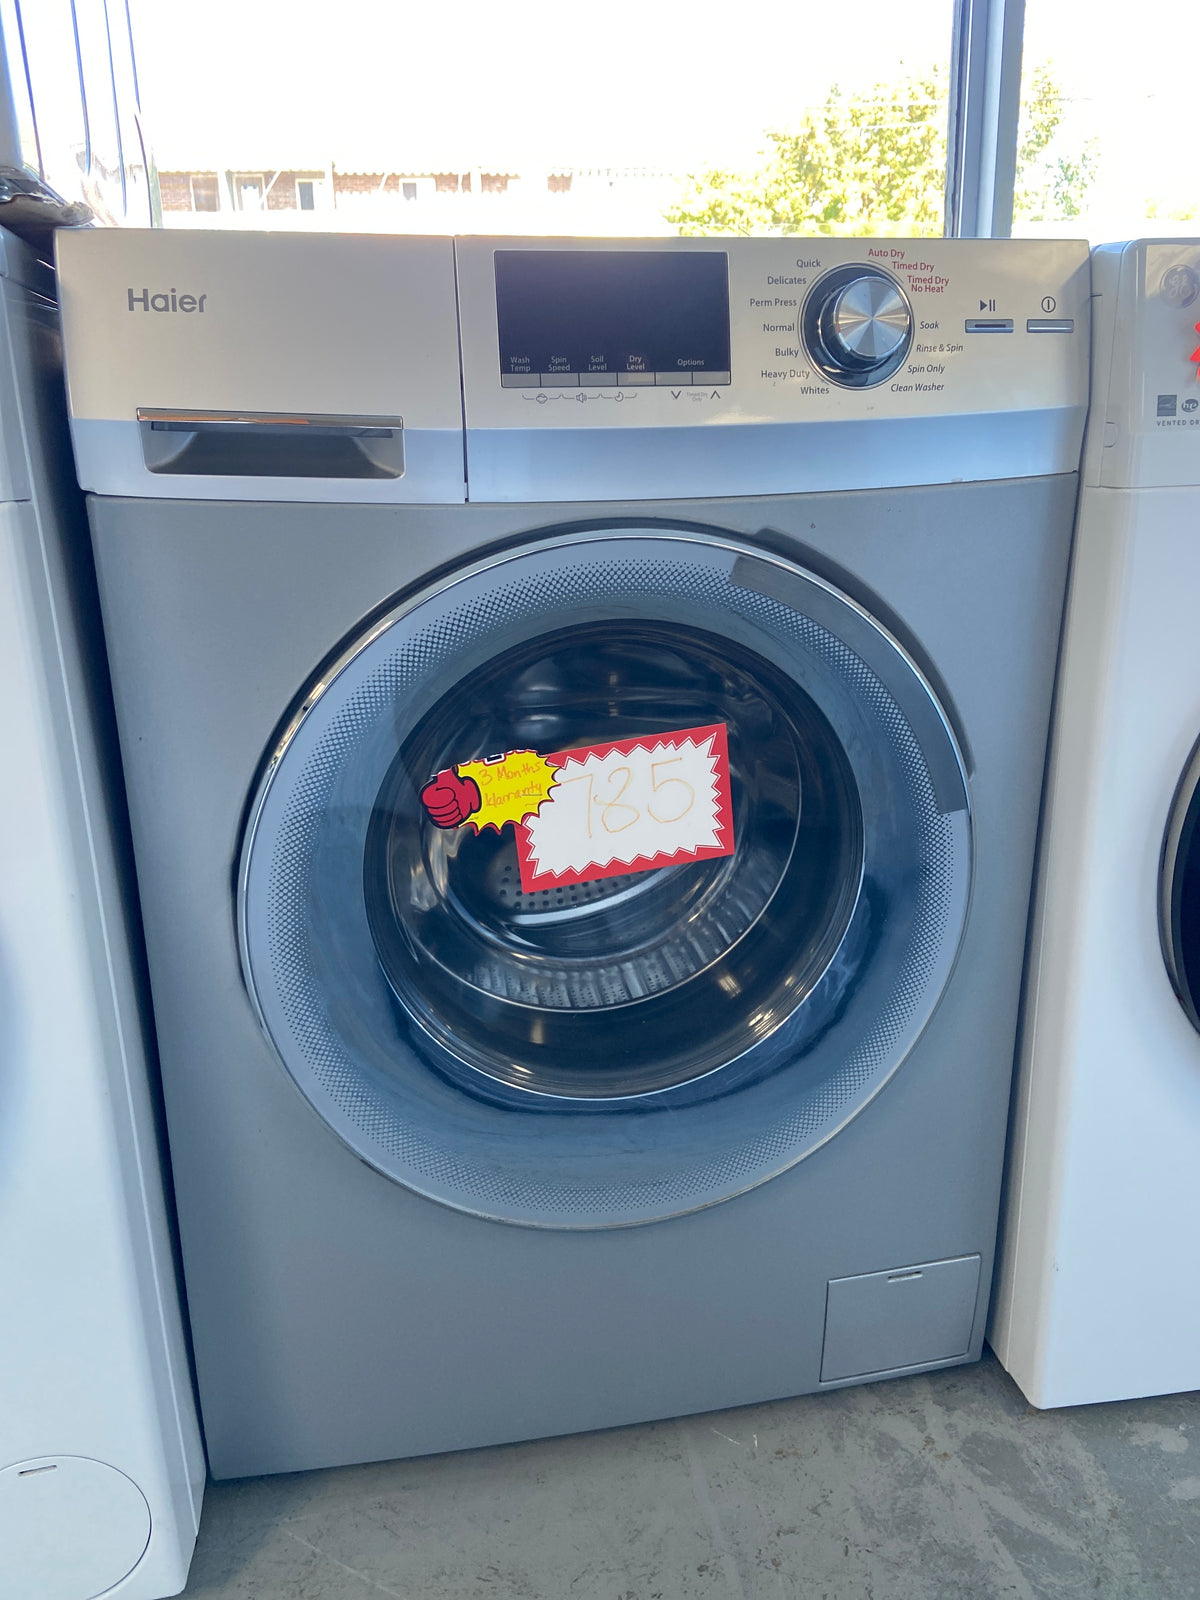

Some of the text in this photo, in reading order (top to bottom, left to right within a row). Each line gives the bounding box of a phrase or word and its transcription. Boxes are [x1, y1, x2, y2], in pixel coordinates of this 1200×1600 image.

[868, 248, 905, 260] Auto Dry
[796, 259, 822, 268] Quick
[892, 261, 935, 272] Timed Dry
[767, 275, 807, 285] Delicates
[907, 275, 950, 286] Timed Dry
[911, 284, 944, 293] No Heat
[127, 288, 207, 312] Haier
[750, 298, 797, 307] Perm Press
[763, 323, 795, 332] Normal
[920, 320, 939, 329] Soak
[916, 343, 964, 353] Rinse & Spin
[775, 348, 799, 358] Bulky
[510, 356, 530, 364] Wash
[551, 356, 567, 364] Spin
[629, 355, 642, 364] Dry
[677, 358, 705, 367] Options
[511, 364, 531, 373] Temp
[548, 364, 571, 372] Speed
[588, 363, 607, 371] Level
[626, 363, 645, 371] Level
[907, 364, 945, 374] Spin Only
[761, 369, 810, 380] Heavy Duty
[800, 386, 830, 394] Whites
[891, 382, 945, 392] Clean Washer
[480, 761, 541, 786] 3 Months
[560, 757, 695, 839] 785
